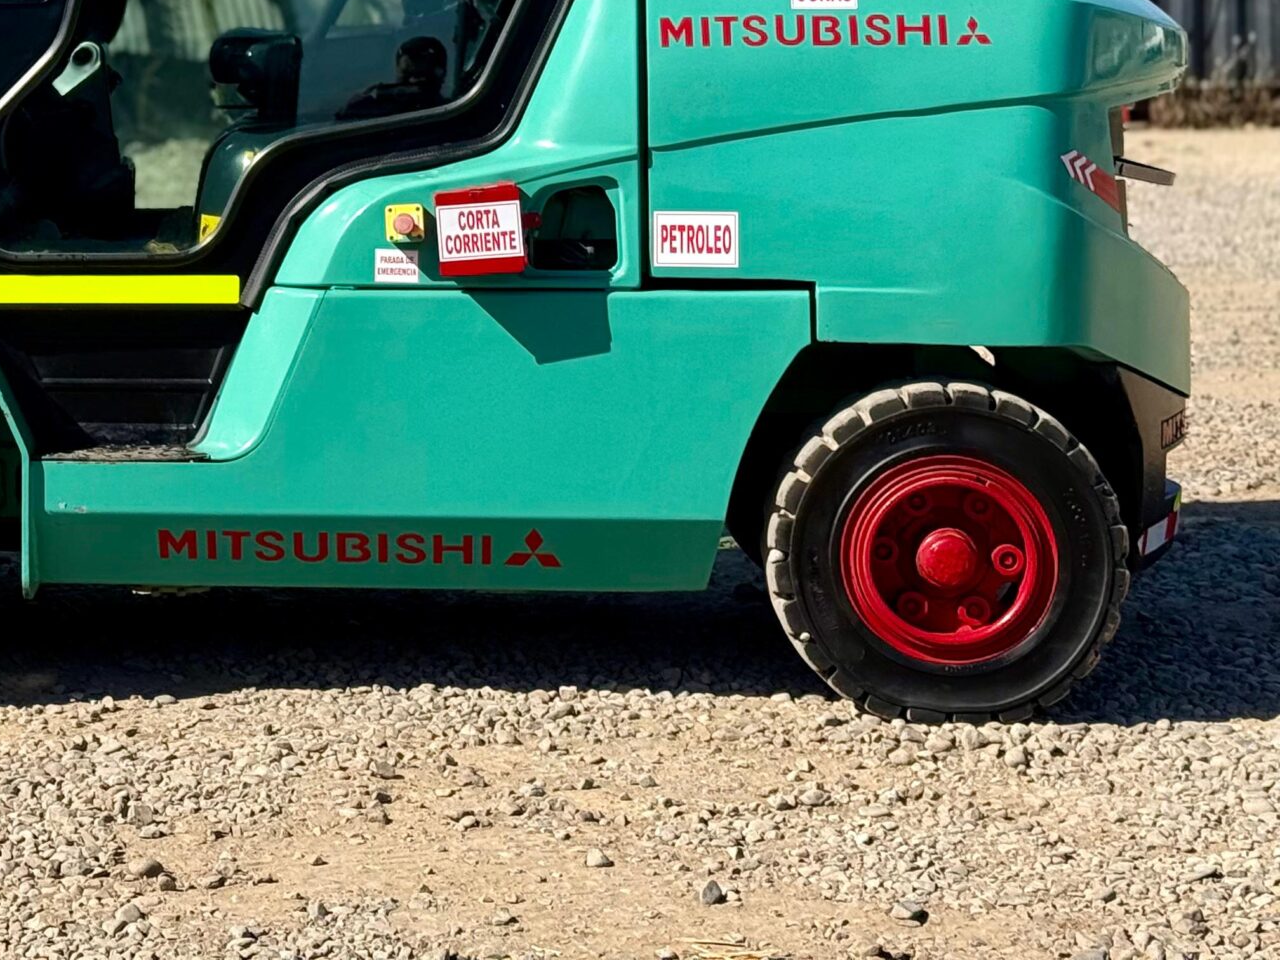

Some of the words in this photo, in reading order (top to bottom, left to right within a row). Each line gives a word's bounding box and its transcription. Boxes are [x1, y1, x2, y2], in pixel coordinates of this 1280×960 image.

[659, 14, 948, 48] MITSUBISHI
[457, 208, 500, 231] CORTA
[445, 230, 517, 255] CORRIENTE
[660, 224, 732, 255] PETROLEO
[377, 267, 417, 276] EMERGENCIA
[380, 256, 404, 264] PARADA
[157, 529, 492, 565] MITSUBISHI
